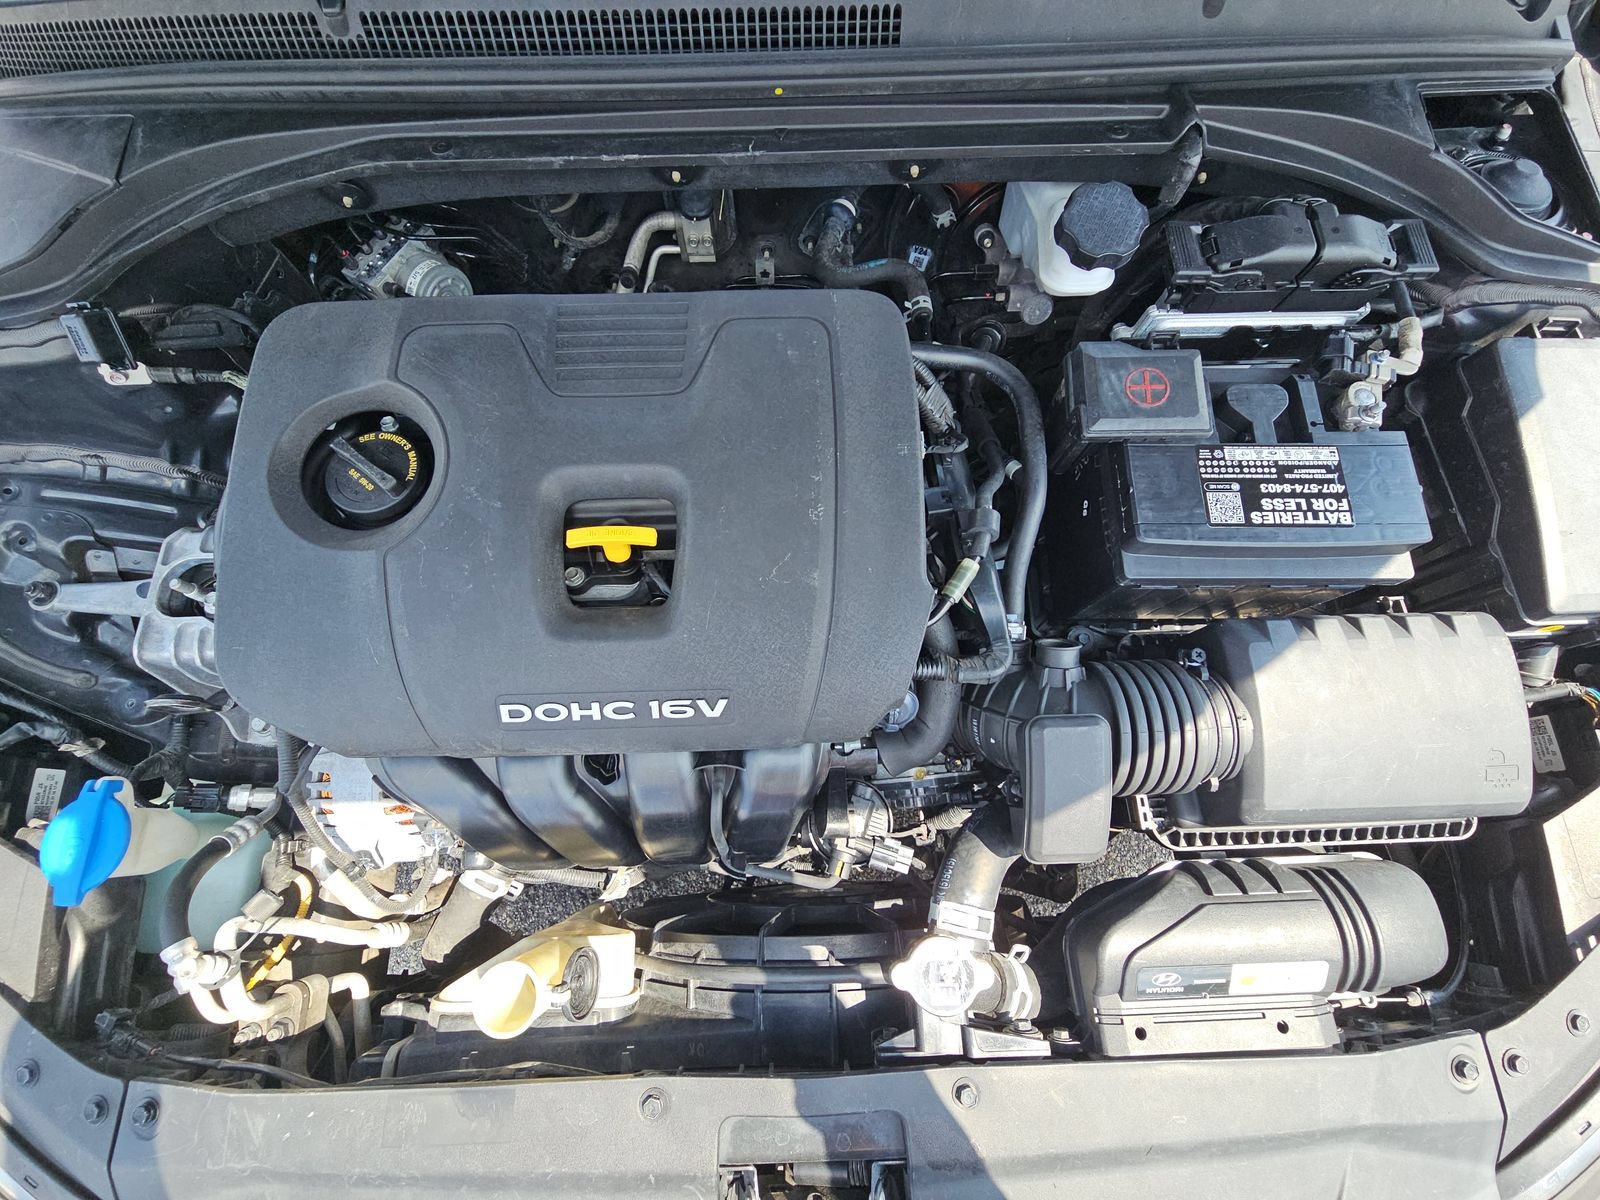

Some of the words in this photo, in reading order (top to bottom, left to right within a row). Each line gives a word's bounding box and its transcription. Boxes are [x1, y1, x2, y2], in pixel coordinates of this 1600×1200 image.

[358, 433, 376, 443] SEE
[378, 432, 412, 451] OWNER'S
[405, 450, 418, 481] MANUAL
[348, 468, 361, 480] SAE
[1259, 483, 1346, 493] 407-574-8403
[1260, 498, 1308, 511] LESS
[1310, 498, 1350, 511] FOR
[1250, 511, 1353, 525] BATTERIES
[499, 701, 636, 723] DOHC
[649, 698, 729, 719] 16V
[1145, 986, 1185, 994] HYUNDAI
